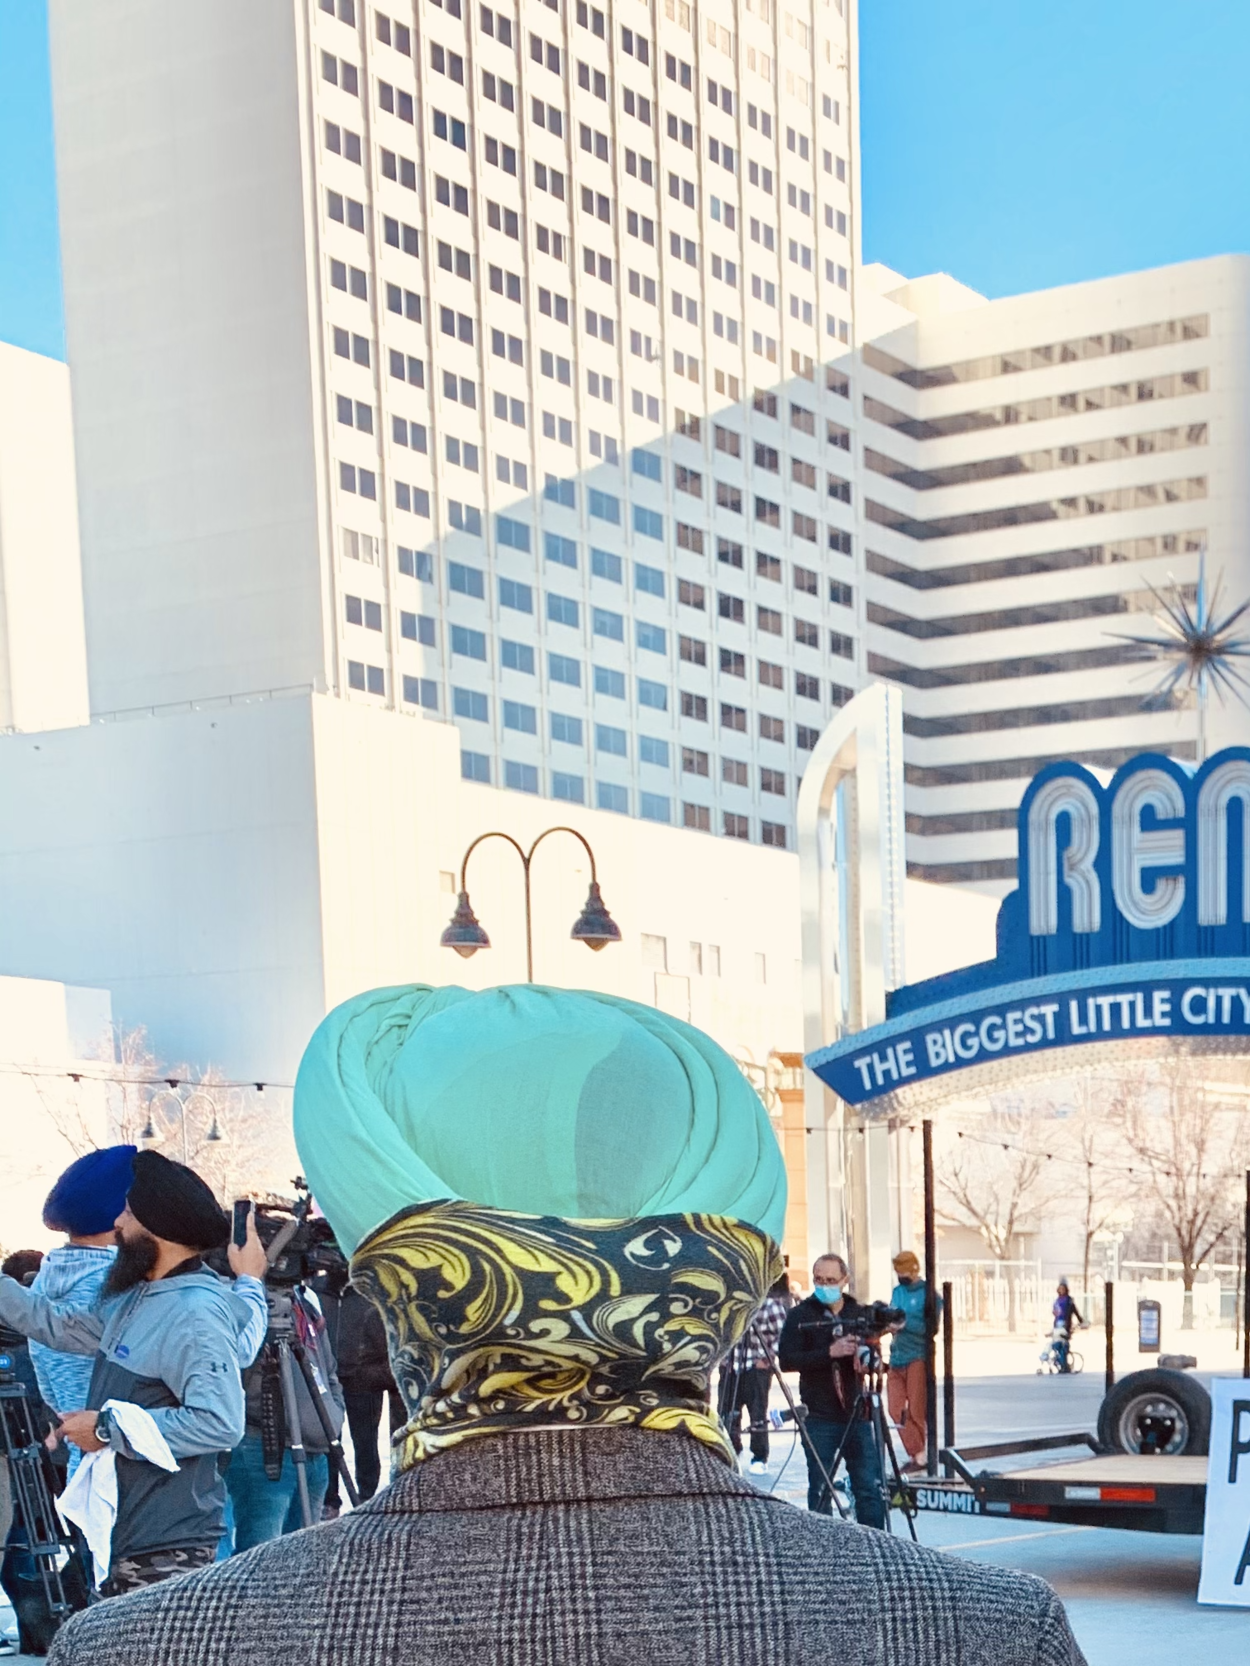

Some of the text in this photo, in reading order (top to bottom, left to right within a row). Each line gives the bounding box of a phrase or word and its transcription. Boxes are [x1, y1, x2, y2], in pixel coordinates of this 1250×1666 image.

[853, 1040, 918, 1092] THE
[924, 1003, 1060, 1069] BIGGEST
[1068, 990, 1172, 1036] LITTLE
